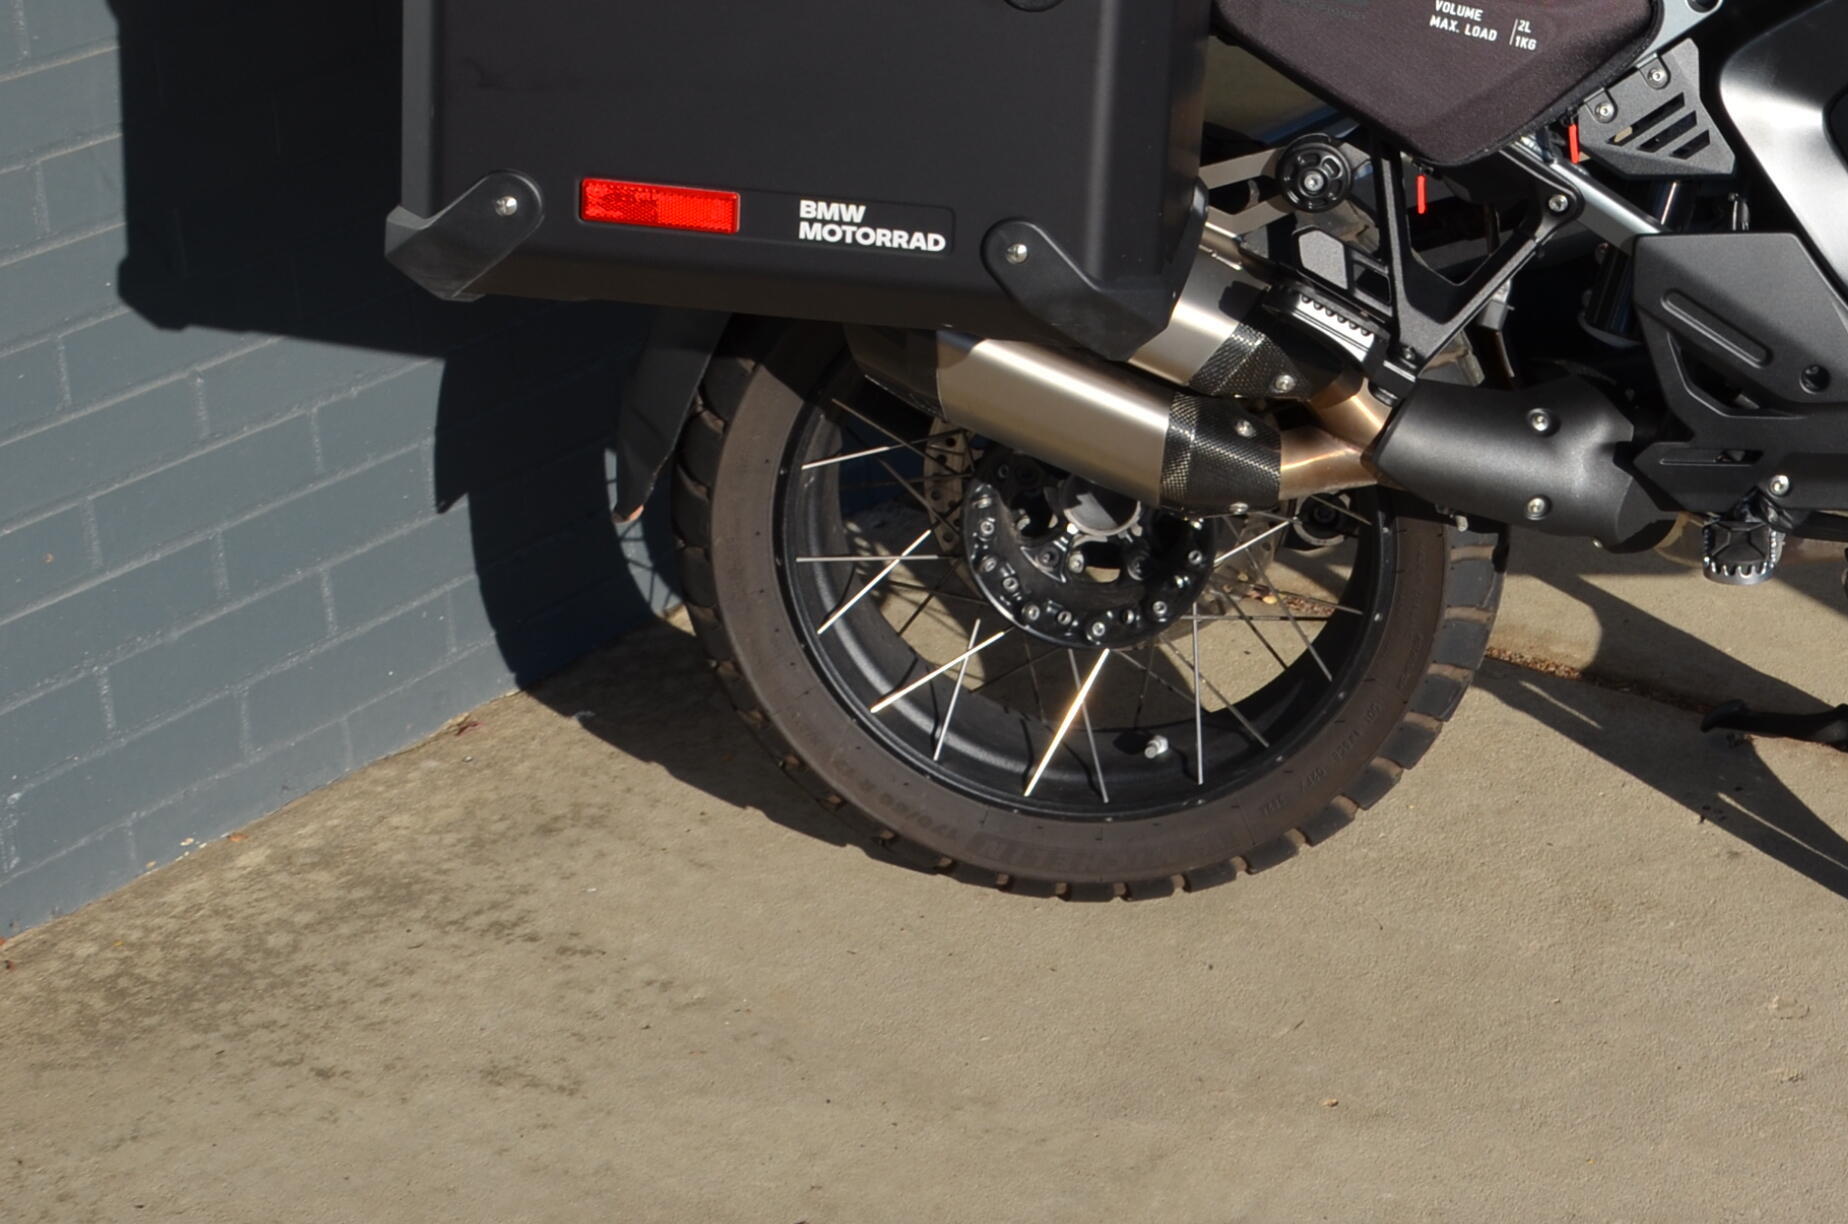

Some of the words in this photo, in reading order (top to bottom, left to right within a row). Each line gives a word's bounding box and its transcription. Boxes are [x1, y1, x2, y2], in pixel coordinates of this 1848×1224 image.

[1428, 14, 1460, 34] MAX.
[1464, 23, 1499, 42] LOAD
[1514, 35, 1537, 51] 1KG
[1517, 18, 1532, 34] 2L
[799, 199, 866, 224] BMW
[798, 220, 947, 253] MOTORRAD
